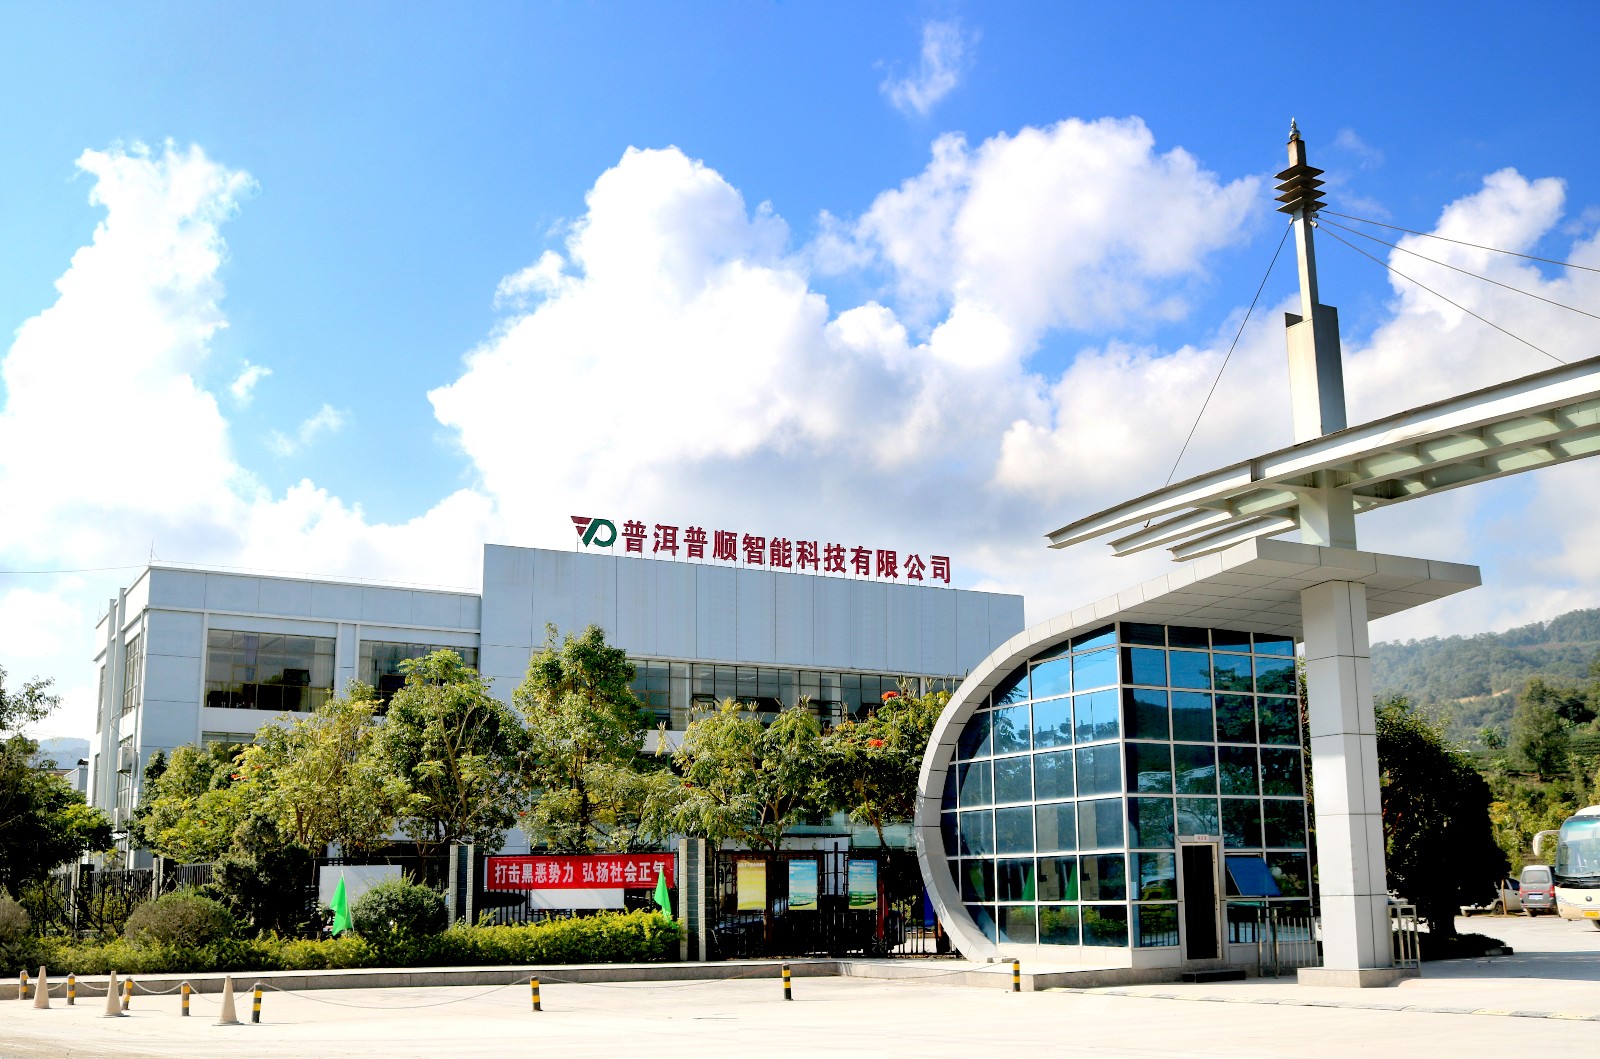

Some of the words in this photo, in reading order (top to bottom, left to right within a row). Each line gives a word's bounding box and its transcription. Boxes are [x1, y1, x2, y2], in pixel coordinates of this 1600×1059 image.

[622, 519, 951, 583] 普洱普顺智能科技有限公司
[495, 862, 574, 884] 打击黑恶势力
